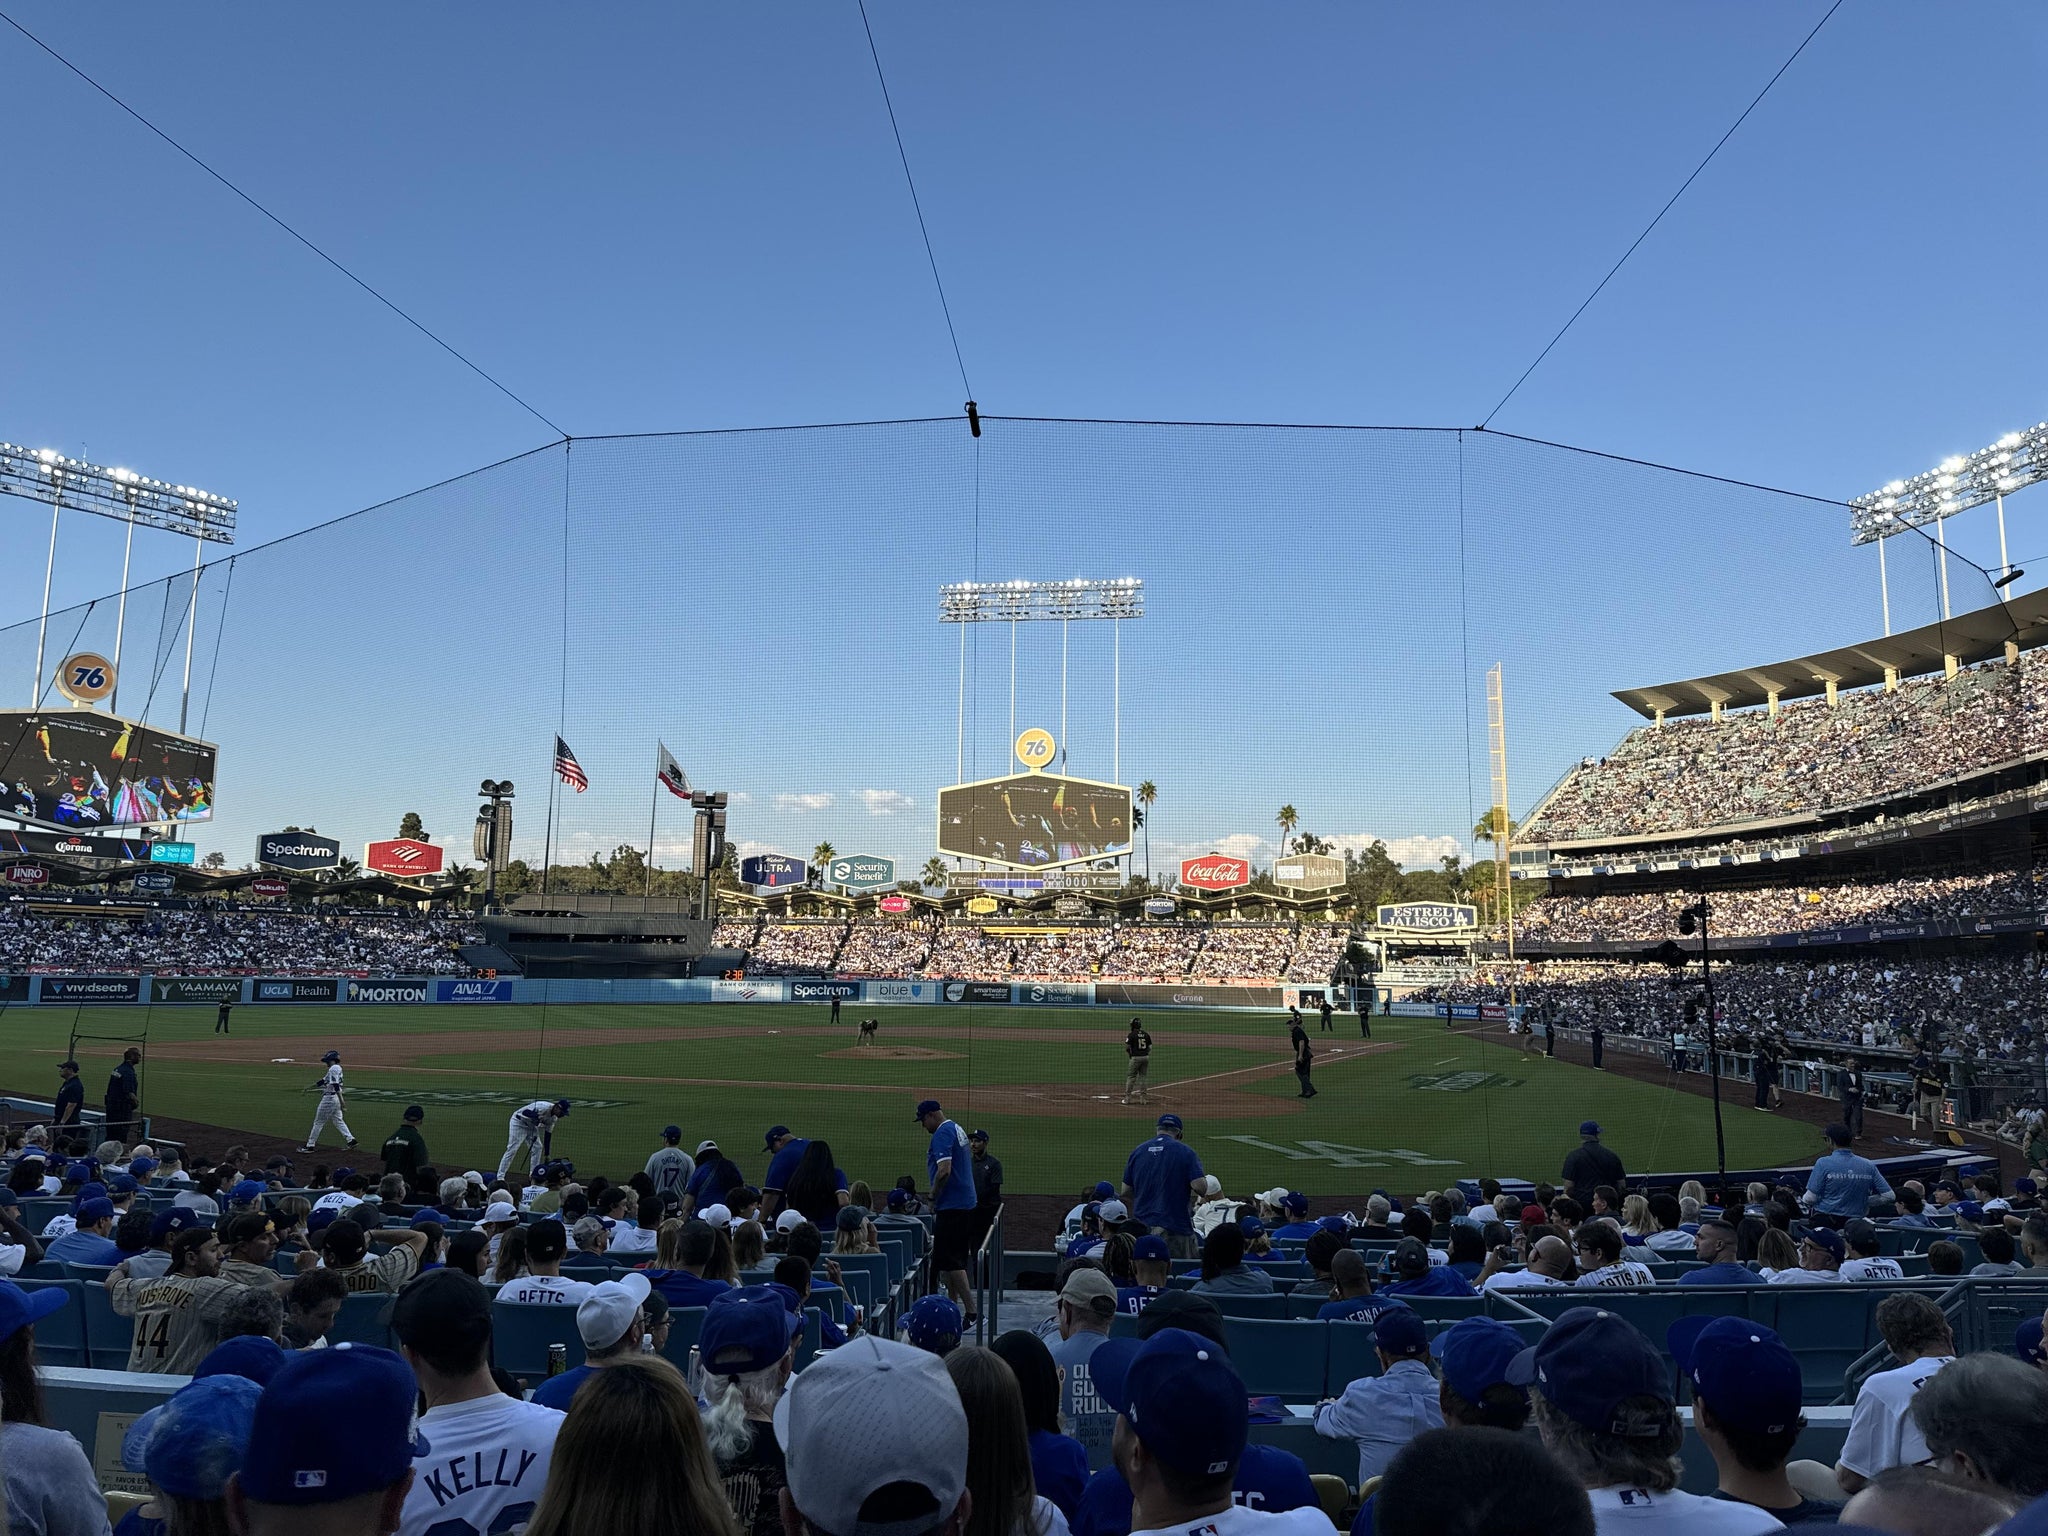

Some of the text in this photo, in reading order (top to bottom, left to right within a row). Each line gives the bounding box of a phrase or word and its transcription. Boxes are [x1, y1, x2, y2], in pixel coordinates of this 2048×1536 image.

[73, 667, 105, 689] 76
[1025, 739, 1047, 756] 76
[55, 841, 93, 853] Corona
[167, 846, 192, 855] Security
[266, 841, 331, 858] Spectrum
[755, 864, 792, 873] ULTRA
[854, 862, 888, 873] Security
[1186, 862, 1242, 882] Coca-Cola
[1307, 867, 1339, 877] Health
[12, 868, 43, 880] JINRO
[854, 872, 885, 881] Benefit
[254, 884, 287, 892] Yakult
[1386, 916, 1450, 926] JALISCO
[477, 968, 496, 980] 2:38
[725, 969, 744, 981] 2:38
[264, 986, 330, 996] UCLA Health
[359, 988, 427, 1001] MORTON
[452, 983, 482, 995] ANA
[794, 984, 850, 998] Spectrum
[879, 984, 908, 996] blue
[1048, 986, 1077, 996] Security
[1048, 994, 1073, 1003] Benefit
[1173, 993, 1203, 1003] Corona
[1287, 994, 1297, 1002] 76
[1483, 1009, 1506, 1017] Yakult
[1138, 1038, 1147, 1050] 15
[663, 1168, 680, 1187] 17
[323, 1195, 347, 1204] BETTS
[136, 1314, 171, 1358] 44
[115, 1476, 136, 1484] FAVOR
[424, 1448, 537, 1507] KELLY
